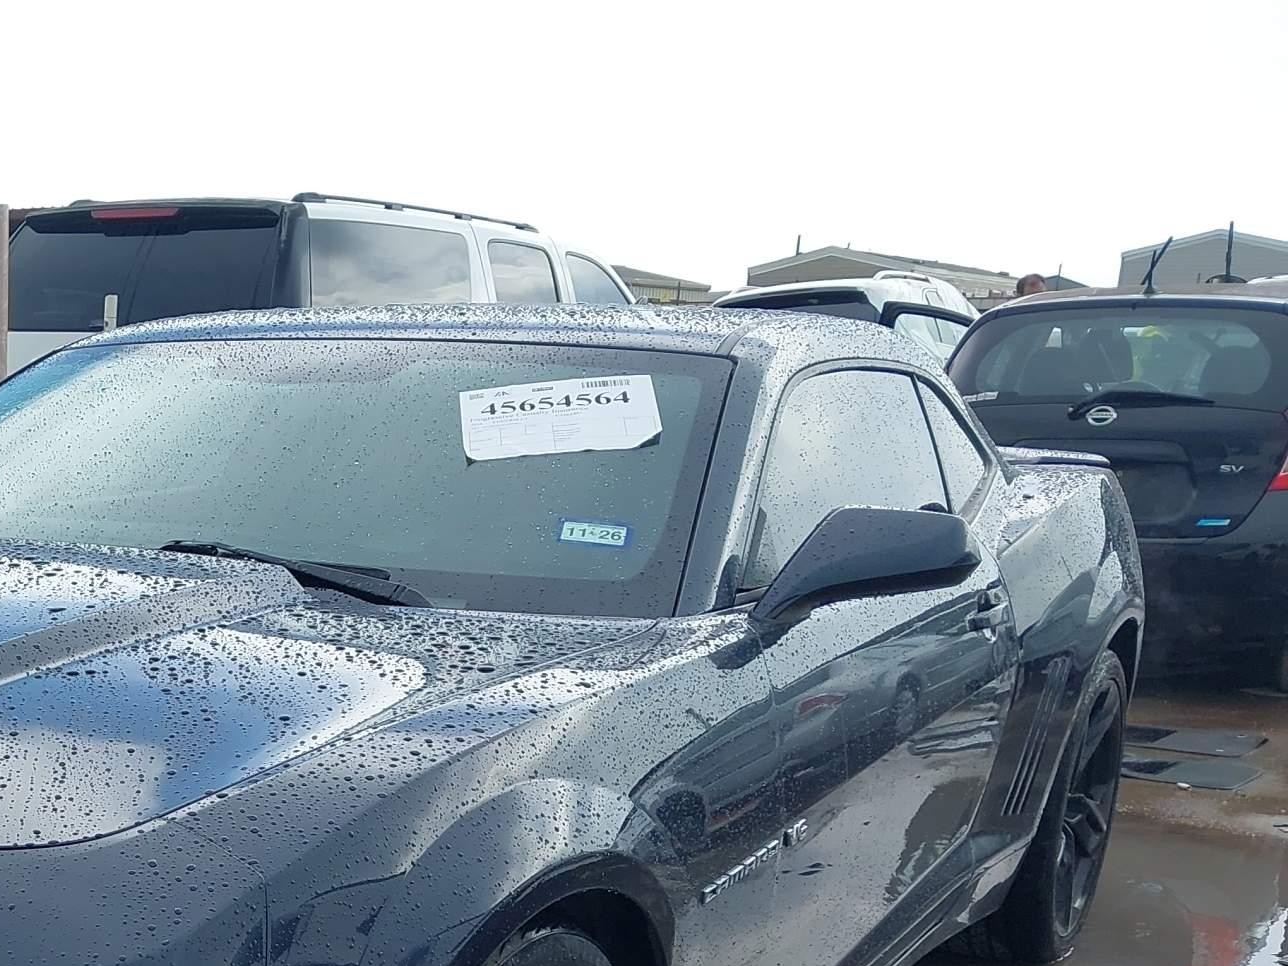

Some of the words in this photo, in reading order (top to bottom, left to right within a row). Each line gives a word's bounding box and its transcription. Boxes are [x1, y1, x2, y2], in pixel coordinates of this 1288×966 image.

[480, 391, 631, 416] 45654564
[1220, 464, 1244, 473] SV
[598, 529, 623, 541] 26
